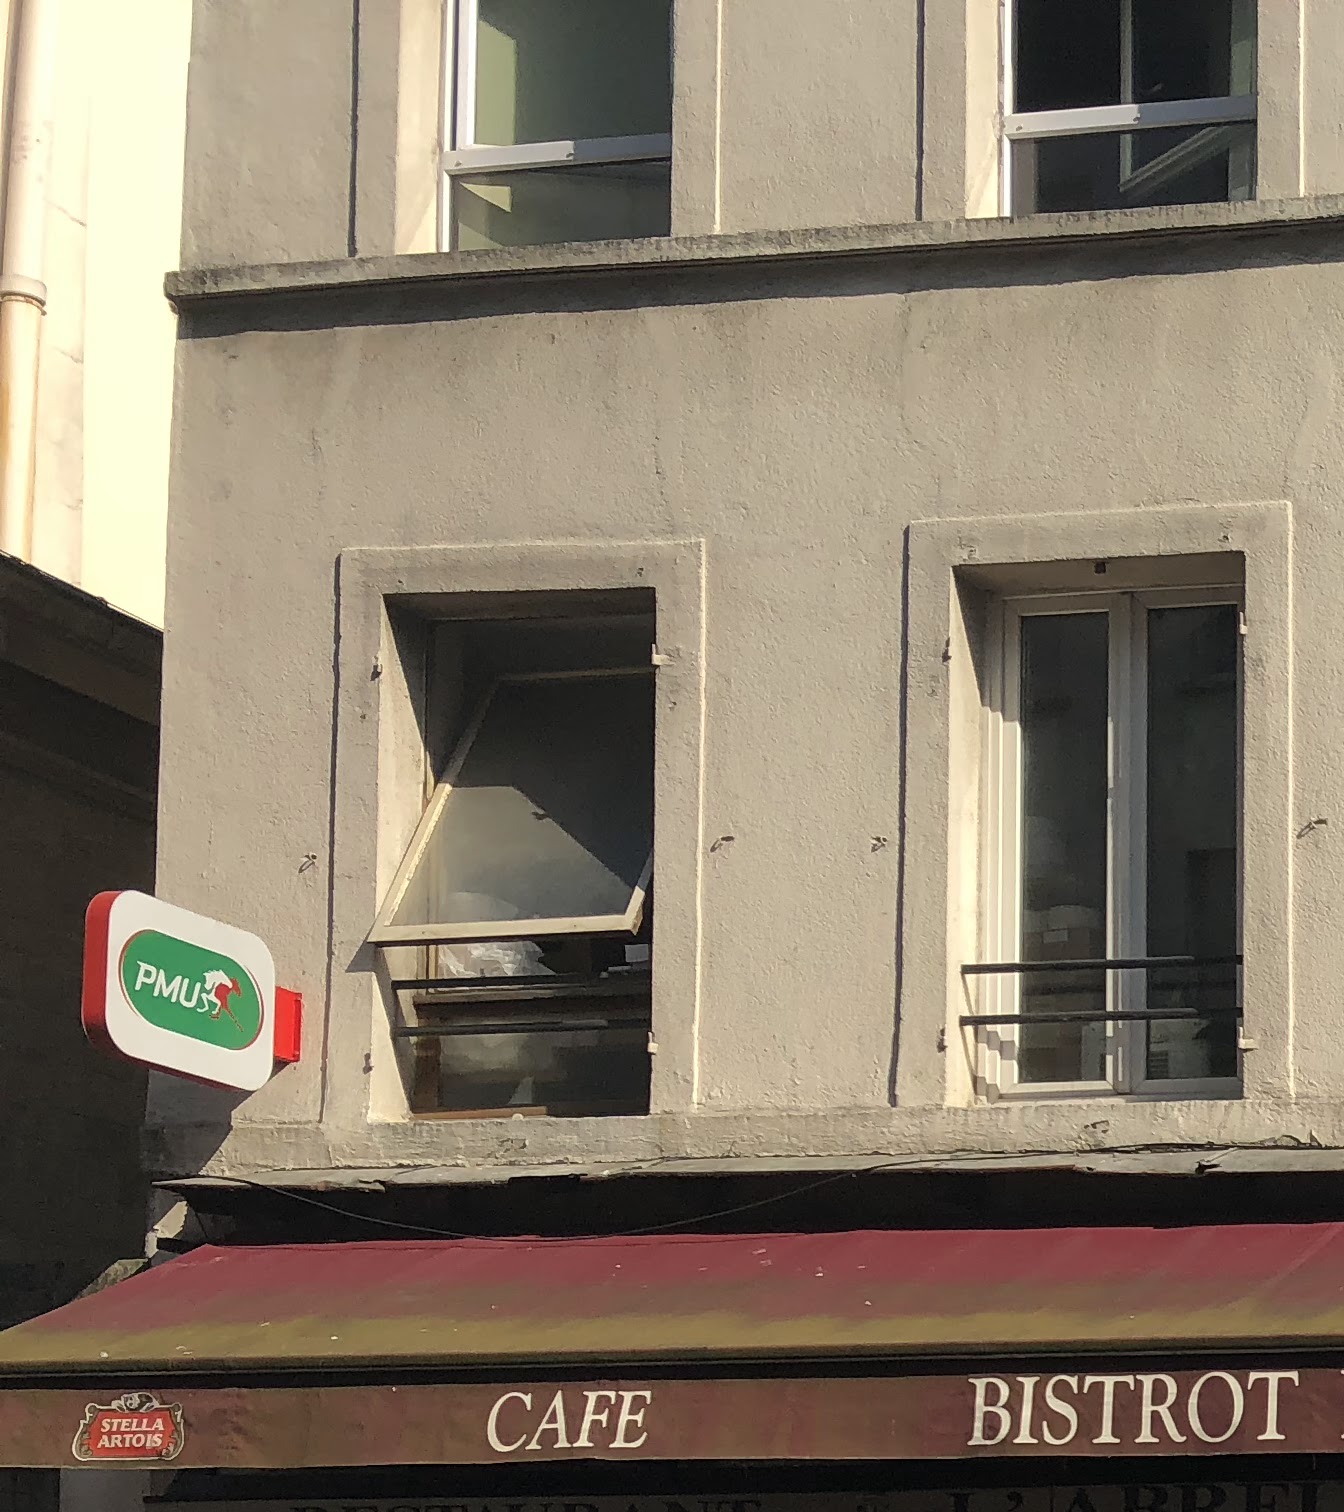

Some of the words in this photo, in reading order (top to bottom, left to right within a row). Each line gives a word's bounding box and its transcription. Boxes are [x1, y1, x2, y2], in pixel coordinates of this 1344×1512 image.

[135, 961, 201, 1008] PMU
[101, 1418, 165, 1433] STELLA
[486, 1390, 652, 1452] CAFE
[967, 1371, 1300, 1446] BISTROT
[97, 1433, 164, 1449] ARTOIS
